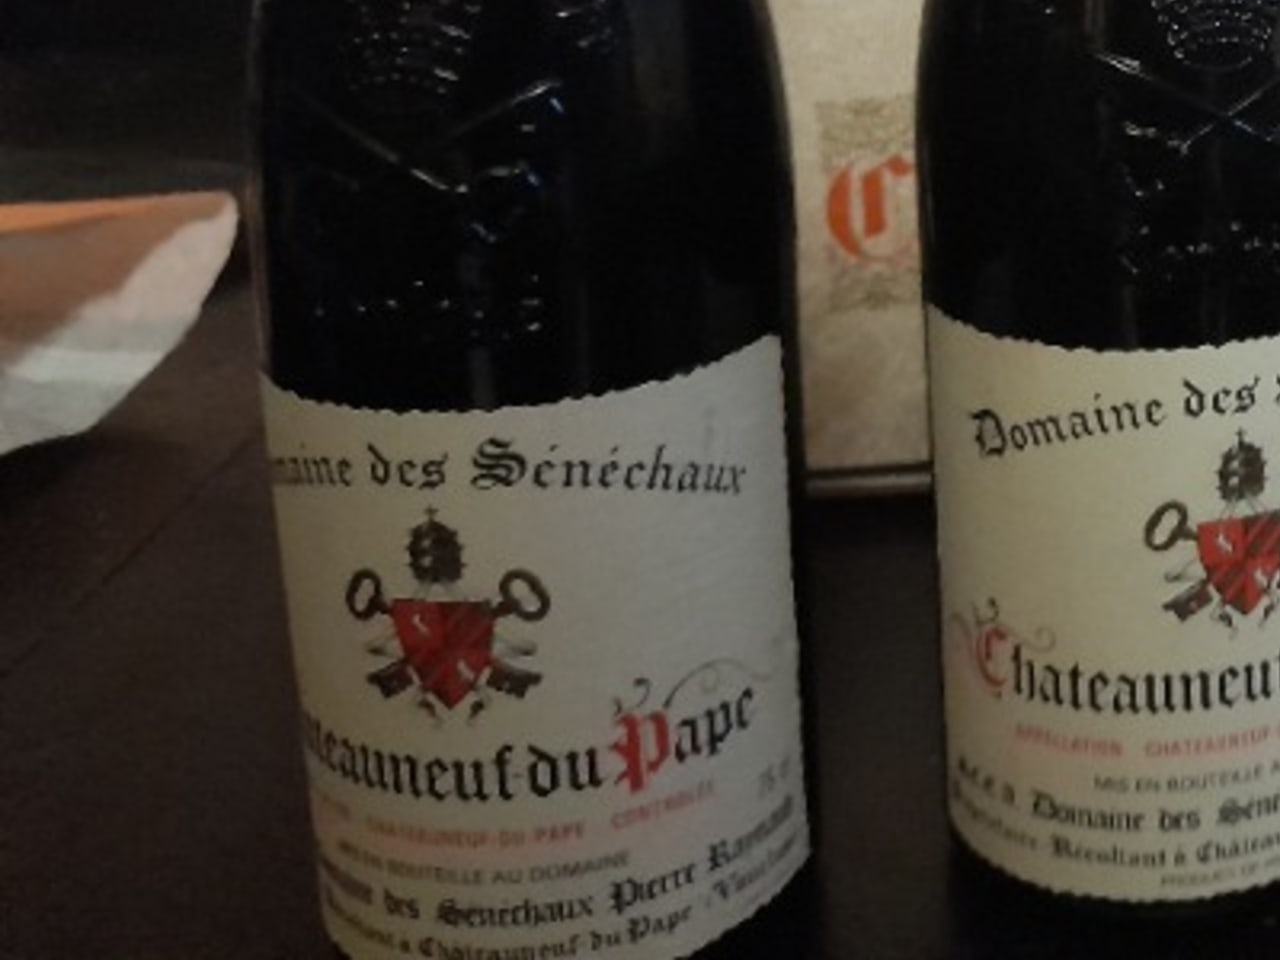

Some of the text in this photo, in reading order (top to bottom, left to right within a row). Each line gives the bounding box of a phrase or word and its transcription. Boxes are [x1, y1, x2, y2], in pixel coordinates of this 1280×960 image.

[968, 392, 1167, 460] Domaine
[1181, 375, 1263, 420] des
[366, 441, 449, 491] des
[470, 436, 747, 495] Sénéchaux
